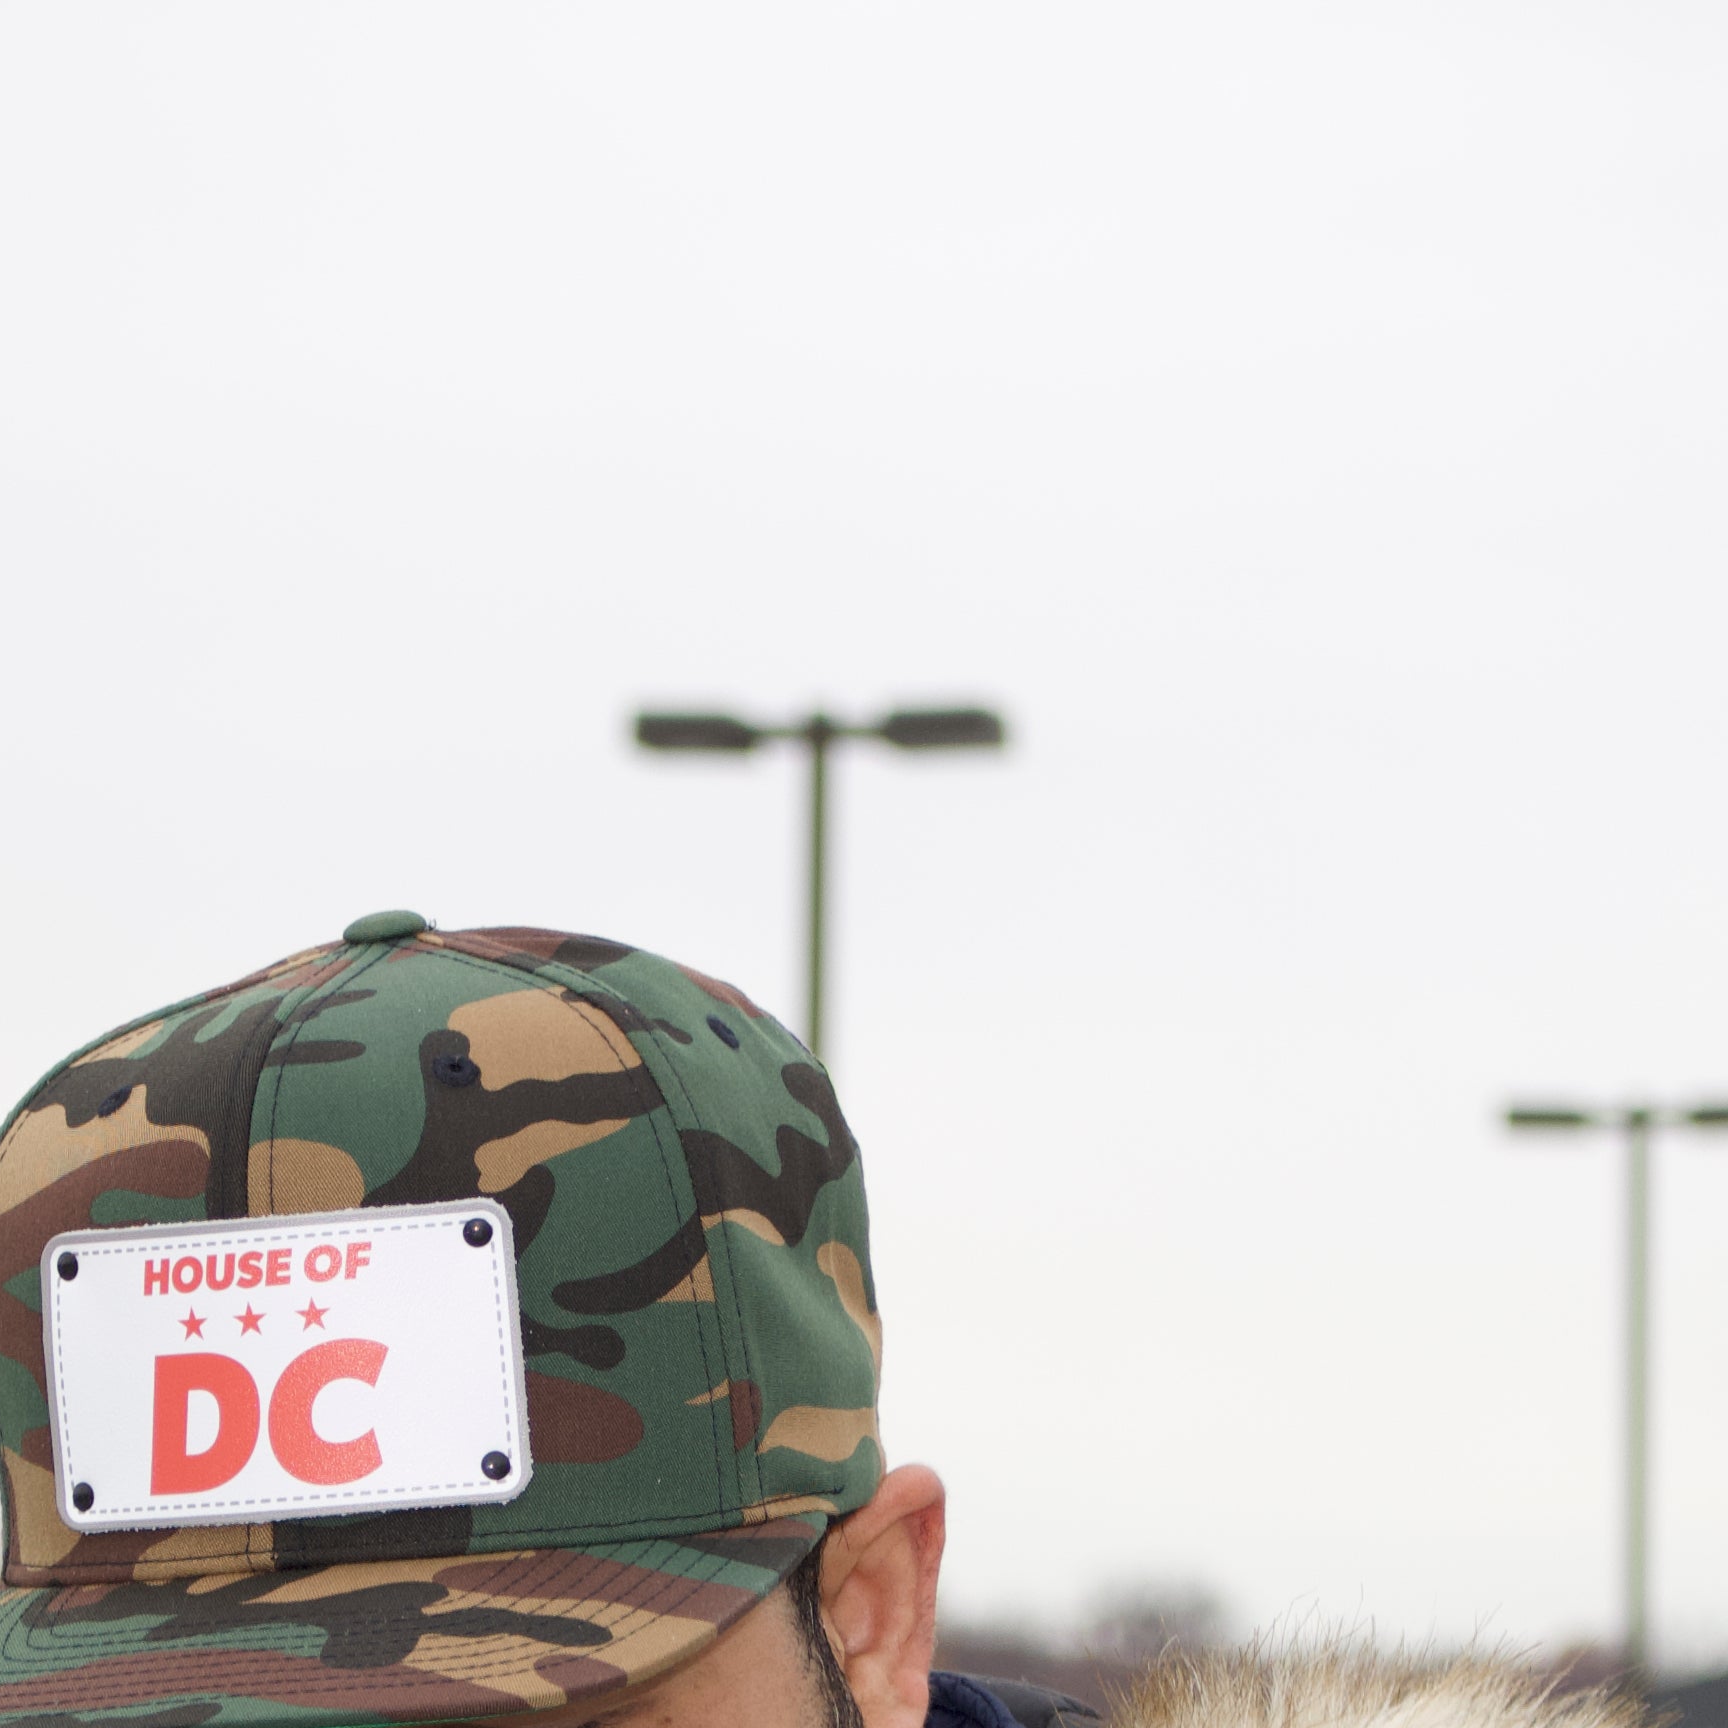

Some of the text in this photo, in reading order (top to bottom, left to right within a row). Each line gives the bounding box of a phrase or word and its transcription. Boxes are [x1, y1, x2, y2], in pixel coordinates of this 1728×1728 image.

[144, 1241, 372, 1296] HOUSE OF
[150, 1338, 389, 1496] DC
